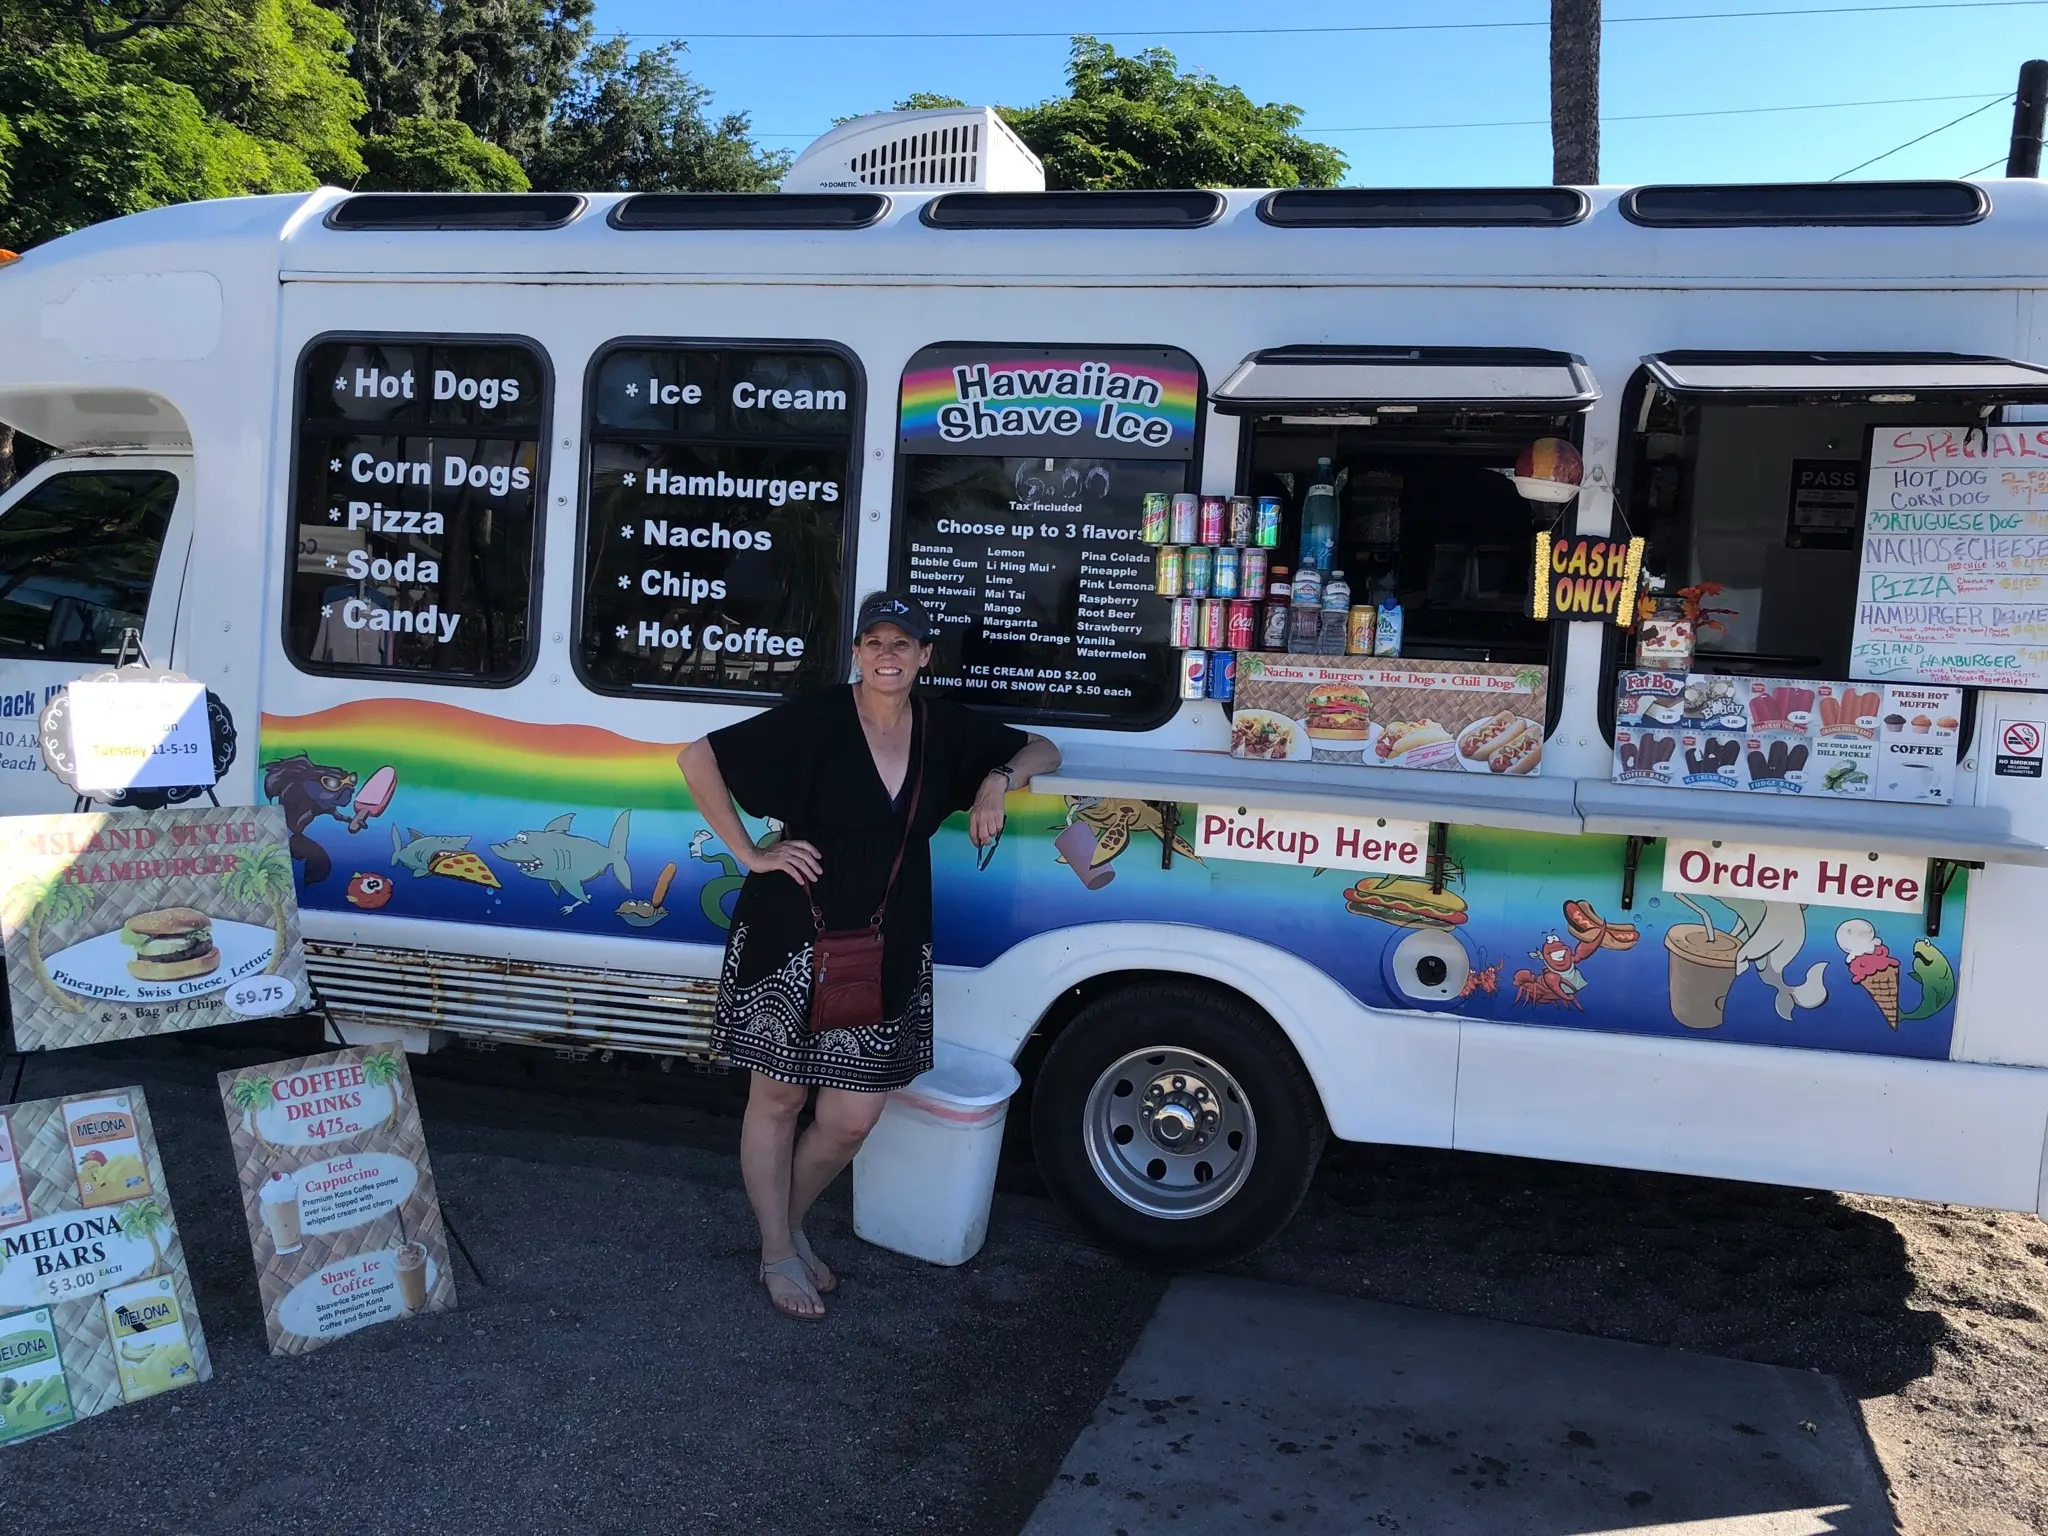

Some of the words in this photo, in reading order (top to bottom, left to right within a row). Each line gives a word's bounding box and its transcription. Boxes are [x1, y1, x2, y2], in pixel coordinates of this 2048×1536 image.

[354, 368, 415, 399] Hot
[434, 370, 520, 409] Dogs
[955, 363, 1162, 406] Hawaiian
[650, 379, 702, 405] Ice
[732, 382, 846, 411] Cream
[940, 401, 1080, 440] Shave
[1098, 403, 1170, 445] Ice
[351, 453, 431, 485] Corn
[444, 456, 530, 496] Dogs
[1801, 472, 1855, 486] PASS
[1894, 469, 1939, 488] HOT
[1946, 470, 1987, 488] DOG
[646, 469, 839, 507] Hamburgers
[1009, 501, 1031, 512] Tax
[1033, 502, 1083, 513] Included
[1950, 491, 1990, 507] DOG
[348, 501, 444, 535] Pizza
[644, 519, 772, 551] Nachos
[937, 519, 1005, 536] Choose
[1011, 524, 1034, 539] up
[1040, 523, 1059, 538] to
[1065, 524, 1077, 538] 3
[912, 543, 953, 554] Banana
[987, 547, 1025, 558] Lemon
[1082, 551, 1108, 562] Pina
[1110, 552, 1150, 563] Colada
[1866, 537, 1951, 565] NACHOS
[346, 550, 439, 584] Soda
[911, 556, 949, 568] Bubble
[953, 558, 978, 569] Gum
[987, 561, 997, 571] Li
[1000, 562, 1026, 573] Hing
[1029, 562, 1049, 573] Mui
[1552, 539, 1627, 578] CASH
[910, 570, 965, 584] Blueberry
[986, 574, 1013, 585] Lime
[1081, 566, 1138, 578] Pineapple
[641, 570, 727, 604] Chips
[910, 584, 935, 596] Blue
[937, 586, 976, 597] Hawaii
[1079, 579, 1105, 590] Pink
[1872, 574, 1956, 601] PIZZA
[985, 589, 1006, 599] Mai
[1009, 589, 1026, 600] Tai
[1078, 594, 1139, 607] Raspberry
[1555, 577, 1622, 615] ONLY
[937, 613, 971, 624] Punch
[984, 603, 1021, 615] Mango
[1078, 608, 1105, 619] Root
[1108, 609, 1136, 619] Beer
[1860, 605, 1987, 626] HAMBURGER
[343, 600, 460, 642] Candy
[983, 617, 1038, 629] Margarita
[1077, 621, 1142, 635] Strawberry
[638, 621, 694, 651] Hot
[702, 627, 804, 657] Coffee
[983, 630, 1027, 642] Passion
[1029, 632, 1070, 645] Orange
[1077, 635, 1115, 646] Vanilla
[1077, 648, 1147, 660] Watermelon
[1854, 643, 1925, 657] ISLAND
[1919, 654, 2022, 669] HAMBURGER
[971, 666, 990, 676] ICE
[993, 666, 1034, 677] CREAM
[1037, 668, 1062, 679] ADD
[1065, 670, 1096, 681] $2.00
[1264, 667, 1304, 679] Nachos
[1319, 669, 1364, 682] Burgers
[1380, 672, 1402, 683] Hot
[1408, 674, 1437, 686] Dogs
[1452, 676, 1481, 688] Chili
[1487, 678, 1516, 691] Dogs
[919, 676, 930, 685] LI
[933, 676, 962, 687] HING
[966, 678, 988, 688] MUI
[991, 679, 1008, 690] OR
[1011, 681, 1046, 692] SNOW
[1049, 682, 1073, 693] CAP
[1076, 684, 1100, 696] $.50
[1103, 686, 1132, 697] each
[1892, 690, 1924, 699] FRESH
[1899, 700, 1939, 709] MUFFIN
[151, 743, 198, 755] 11-5-19
[1839, 751, 1871, 759] PICKLE
[1890, 745, 1943, 756] COFFEE
[37, 828, 156, 857] ISLAND
[170, 822, 257, 848] STYLE
[1204, 814, 1319, 864] Pickup
[1336, 826, 1418, 864] Here
[63, 855, 241, 884] HAMBURGER
[1679, 851, 1799, 892] Order
[1817, 860, 1920, 902] Here
[52, 969, 130, 998] Pineapple,
[137, 987, 172, 997] Swiss
[178, 976, 227, 994] Cheese,
[230, 948, 273, 978] Lettuce
[235, 987, 284, 1006] $9.75
[101, 1012, 112, 1023] &
[120, 1012, 128, 1021] a
[135, 1006, 160, 1018] Bag
[167, 1002, 180, 1012] of
[187, 998, 223, 1011] Chips
[272, 1065, 366, 1101] COFFEE
[285, 1092, 362, 1121] DRINKS
[77, 1118, 126, 1136] MELONA
[327, 1158, 353, 1174] Iced
[305, 1168, 379, 1193] Cappuccino
[302, 1193, 333, 1207] Premium
[334, 1190, 352, 1199] Kona
[353, 1183, 375, 1193] Coffee
[376, 1177, 399, 1189] poured
[306, 1213, 336, 1227] whipped
[337, 1208, 357, 1218] cream
[358, 1203, 372, 1212] and
[373, 1198, 395, 1209] cherry.
[2, 1214, 124, 1258] MELONA
[33, 1242, 106, 1277] BARS
[100, 1265, 122, 1277] EACH
[321, 1268, 356, 1286] Shave
[362, 1261, 381, 1273] Ice
[332, 1277, 375, 1296] Coffee
[118, 1302, 170, 1328] MELONA
[318, 1313, 333, 1322] with
[334, 1304, 364, 1318] Premium
[366, 1297, 384, 1306] Kona
[320, 1321, 342, 1332] Coffee
[344, 1316, 357, 1325] and
[358, 1309, 377, 1320] Snow
[378, 1304, 391, 1314] Cap
